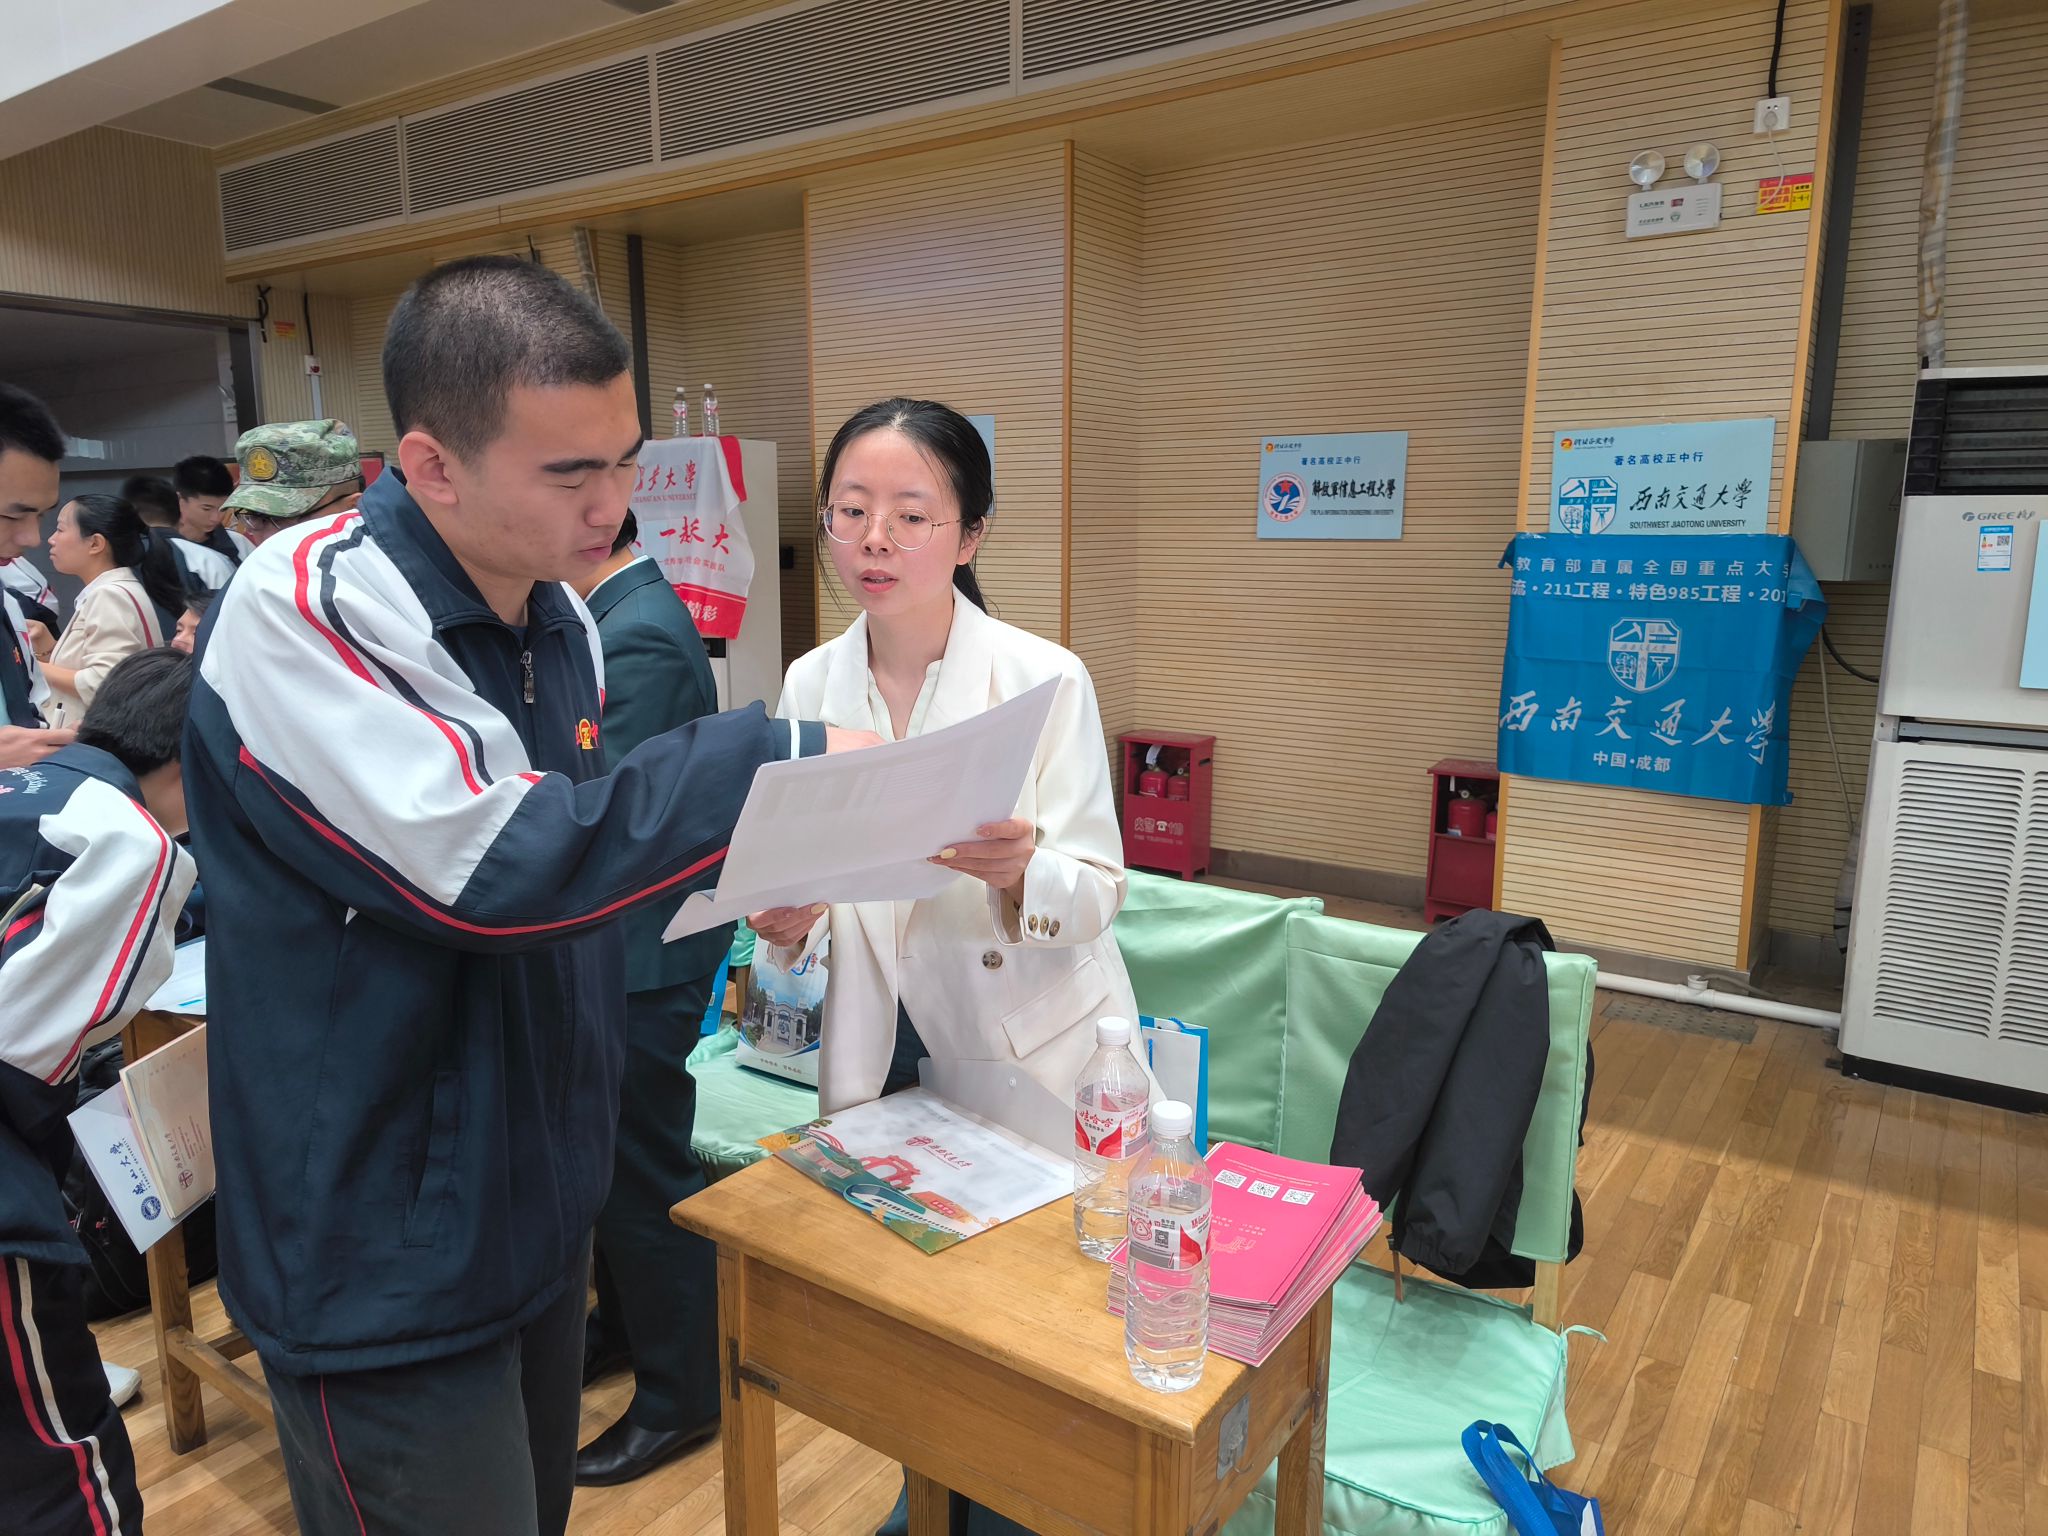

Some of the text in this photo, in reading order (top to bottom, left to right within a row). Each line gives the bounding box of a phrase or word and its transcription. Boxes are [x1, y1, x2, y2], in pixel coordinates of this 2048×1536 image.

[1614, 452, 1703, 466] 著名高校正中行
[1977, 511, 2015, 520] GREE
[1629, 518, 1747, 529] SOUTHWEST JIAOTONG UNIVERSITY
[1080, 1109, 1114, 1128] 娃哈哈
